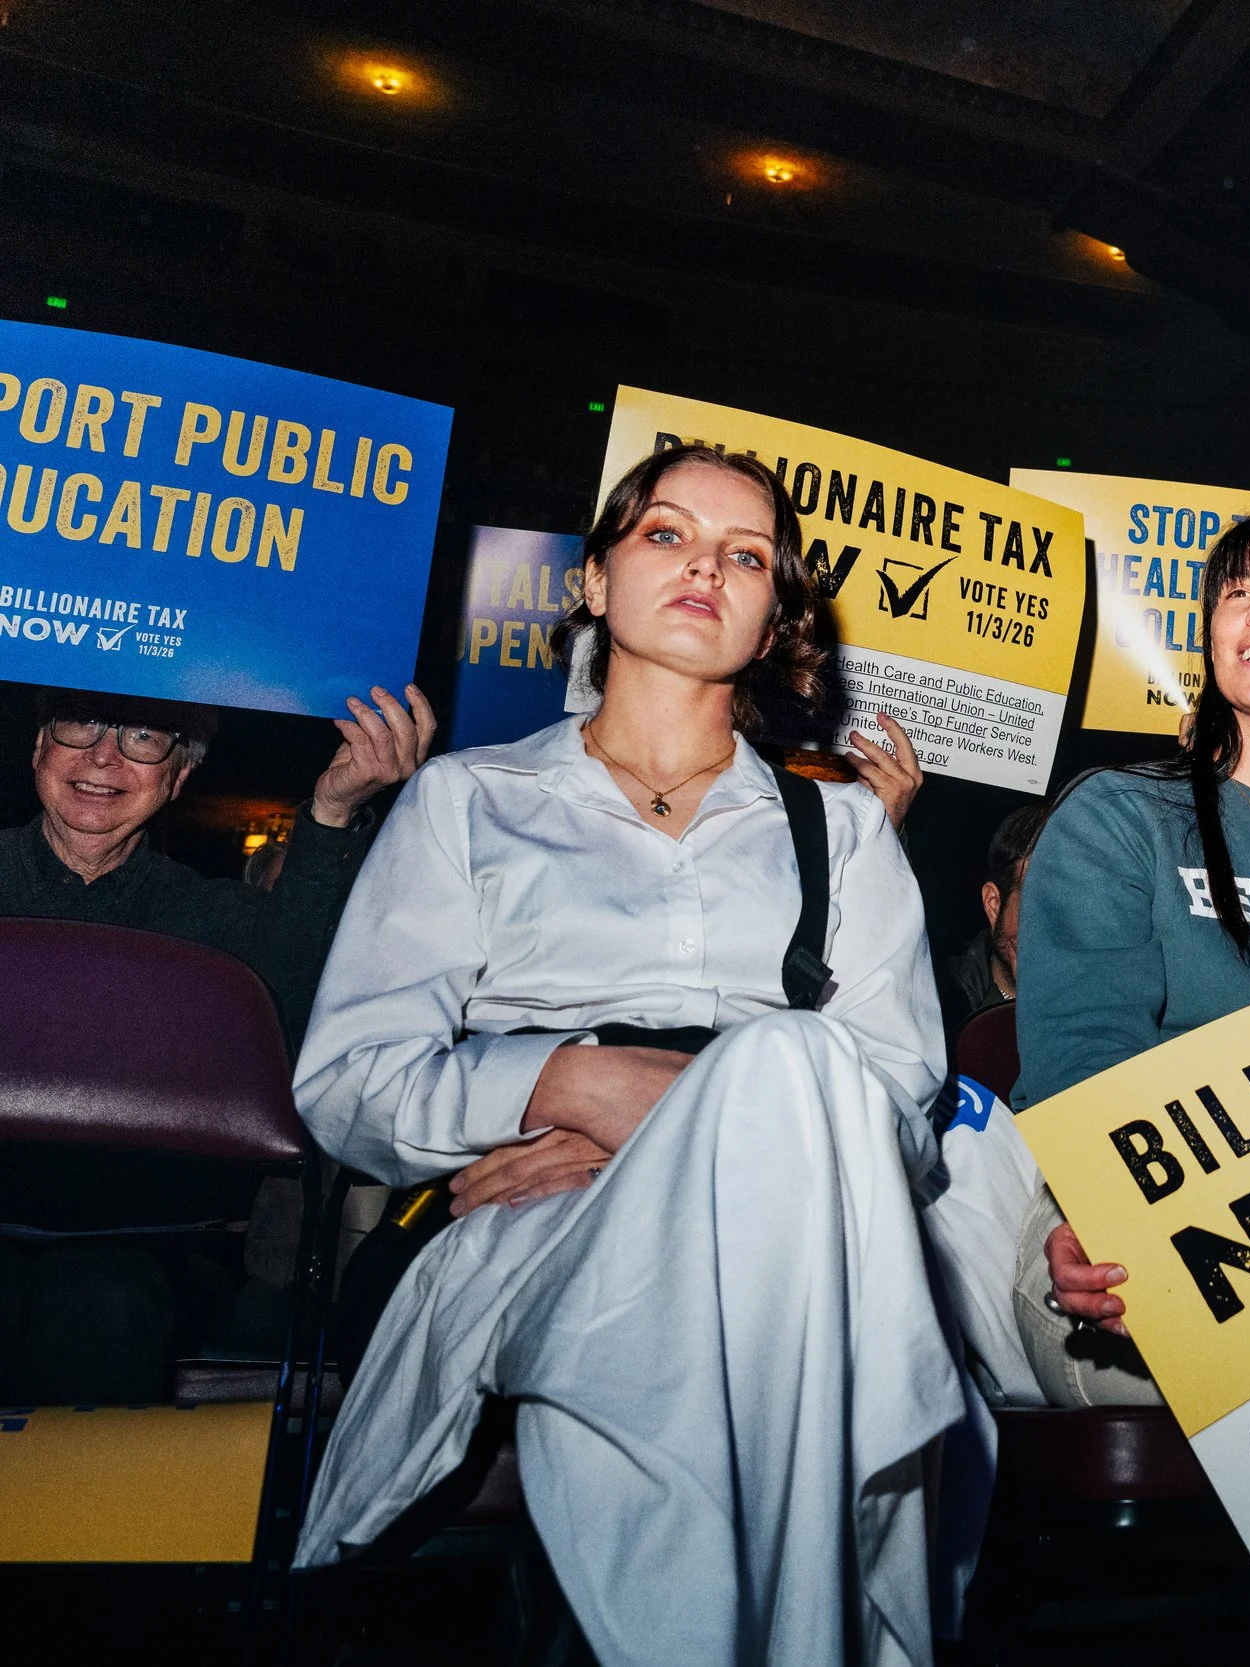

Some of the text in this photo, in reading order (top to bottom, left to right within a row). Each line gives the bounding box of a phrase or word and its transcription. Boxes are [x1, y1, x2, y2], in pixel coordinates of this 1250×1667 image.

[175, 402, 413, 506] PUBLIC
[0, 463, 304, 572] UCATION
[654, 431, 1054, 579] ONAIRE TAX
[1128, 503, 1221, 550] STOP
[959, 576, 1050, 620] VOTE YES
[1098, 553, 1206, 601] HEALT
[0, 613, 90, 646] NOW
[1, 585, 188, 630] BILLIONAIRE TAX
[965, 610, 1035, 648] 11/3/26
[135, 631, 183, 647] VOTE YES
[138, 645, 175, 658] 11/3/26
[455, 617, 553, 670] PEN
[836, 657, 1044, 714] Health Care and Public Education,
[869, 680, 948, 708] International
[950, 698, 985, 718] Union
[998, 710, 1036, 729] United
[843, 696, 1032, 746] ommittee's Top Funder Service
[957, 736, 1004, 759] Workers
[1008, 748, 1038, 766] West.
